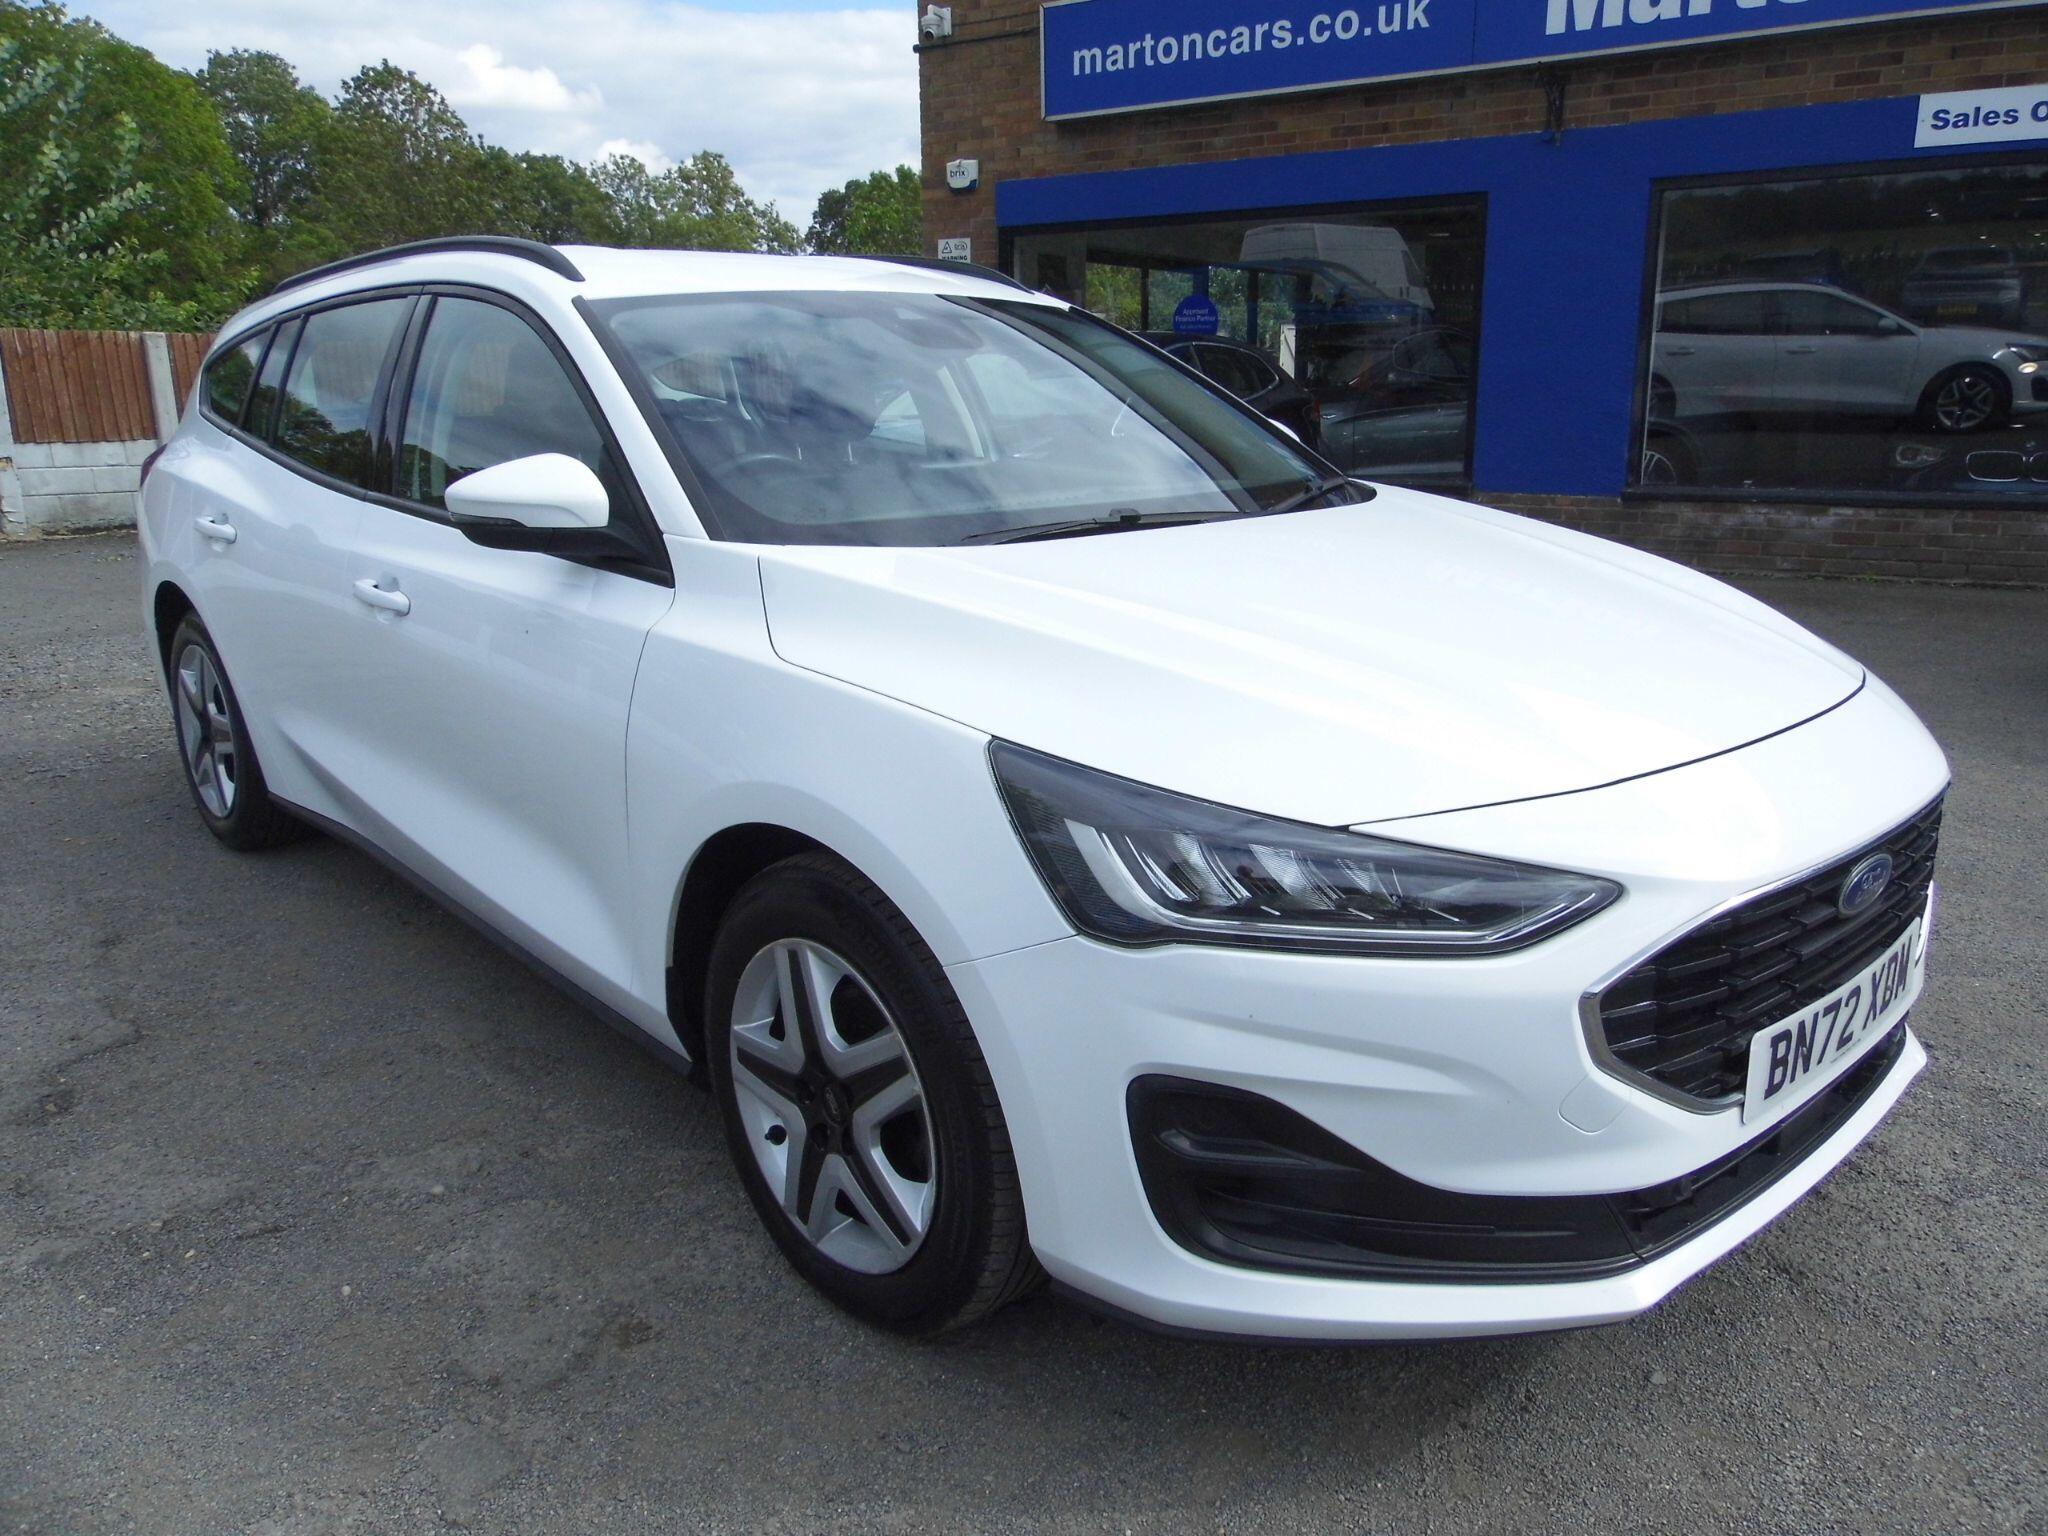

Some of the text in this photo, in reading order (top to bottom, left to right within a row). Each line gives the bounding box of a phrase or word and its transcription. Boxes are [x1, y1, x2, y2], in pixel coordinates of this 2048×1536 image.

[1073, 0, 1431, 76] martoncars.co.uk
[1930, 106, 2019, 131] Sales
[1763, 934, 1912, 1100] BN72 XBN
